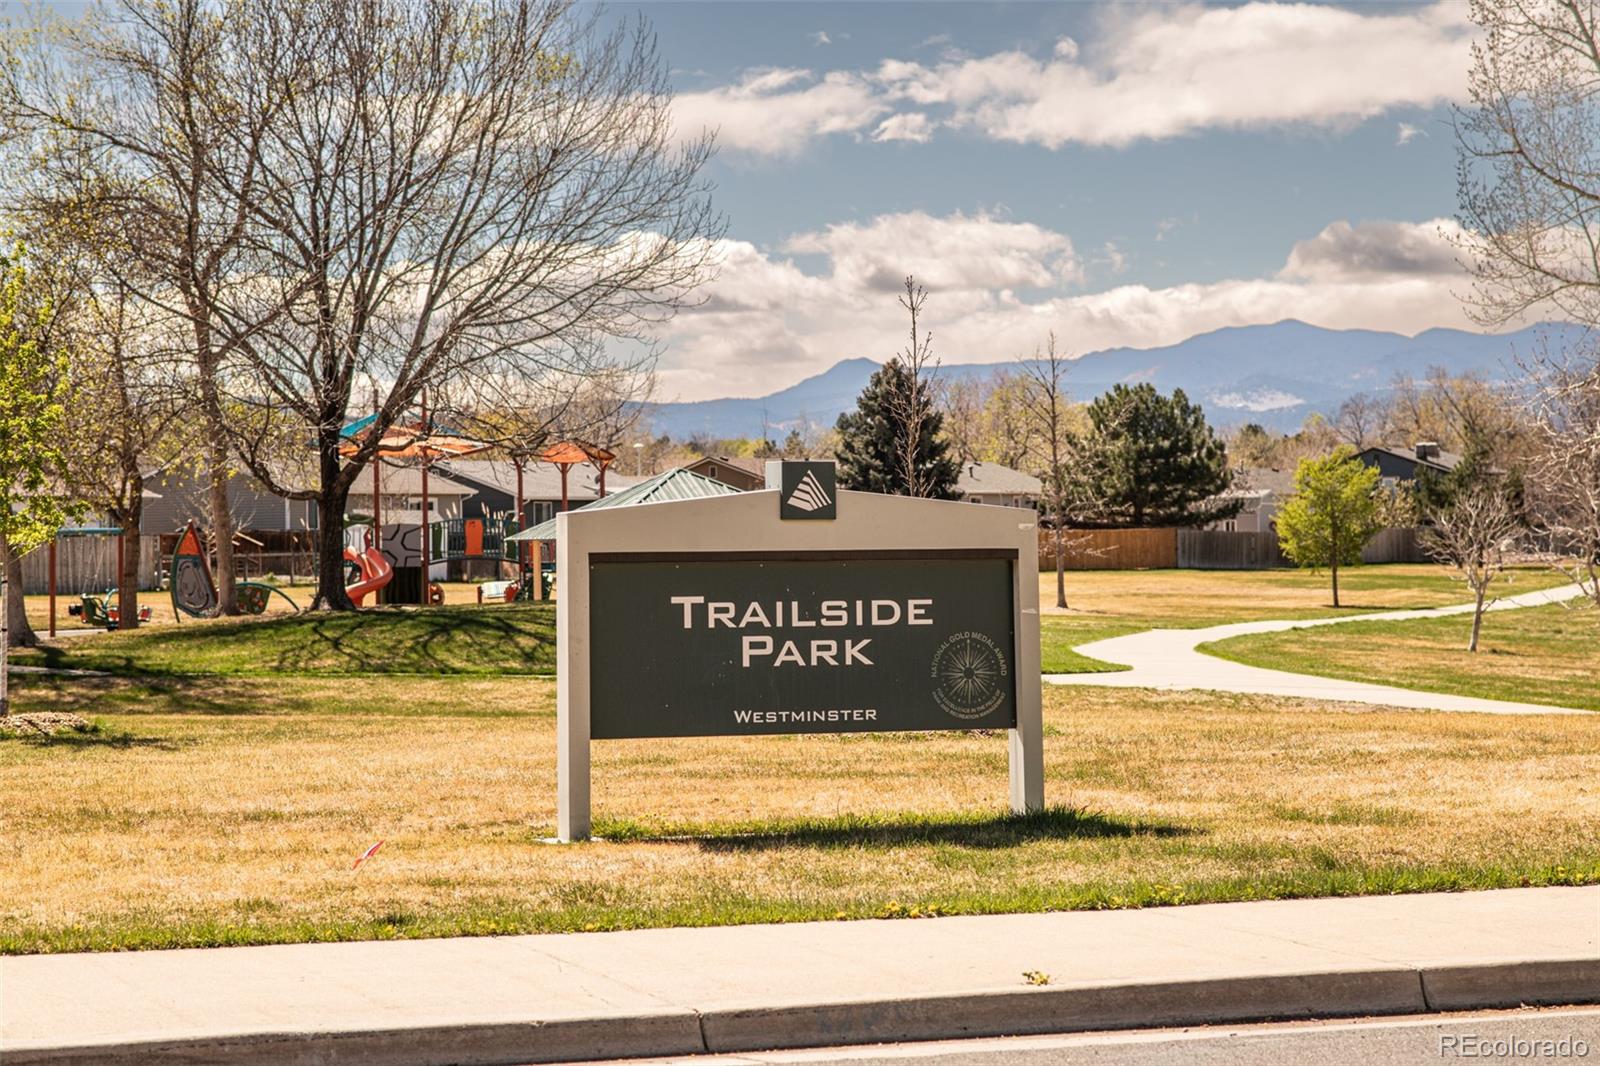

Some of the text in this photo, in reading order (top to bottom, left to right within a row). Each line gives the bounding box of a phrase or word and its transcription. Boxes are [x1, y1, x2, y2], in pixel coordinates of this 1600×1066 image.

[671, 596, 933, 628] TRAILSIDE
[742, 636, 873, 667] PARK
[931, 631, 1007, 678] NATIONAL GOLD MEDAL AWARD
[734, 710, 876, 723] WESTMINSTER
